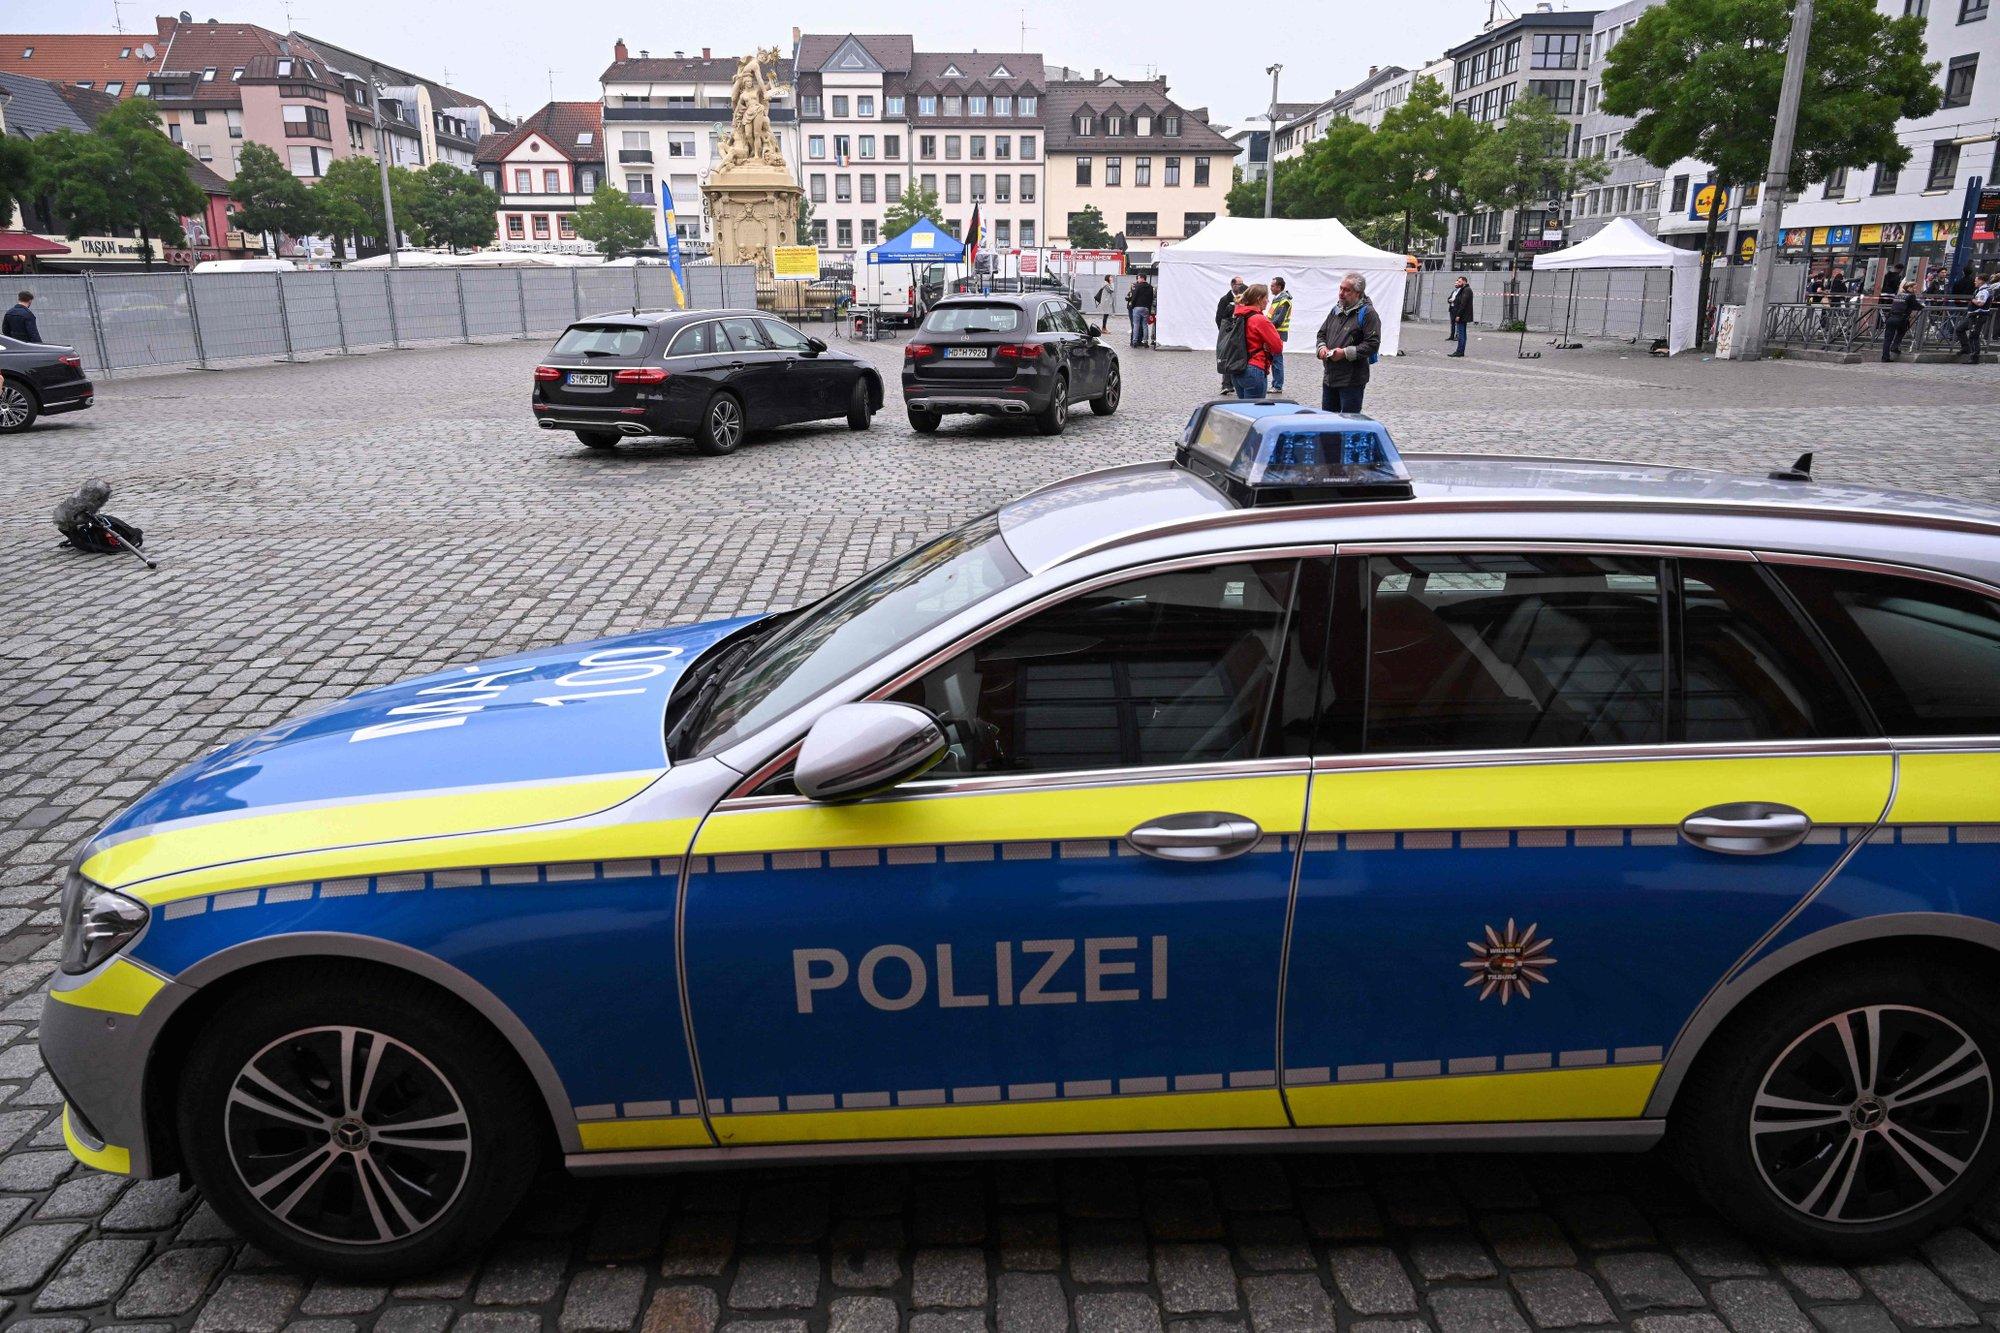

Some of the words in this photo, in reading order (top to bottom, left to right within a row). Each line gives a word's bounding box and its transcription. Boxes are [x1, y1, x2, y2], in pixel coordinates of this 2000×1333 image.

[590, 375, 607, 384] 5704
[533, 646, 685, 706] 100
[793, 935, 1168, 1014] POLIZEI
